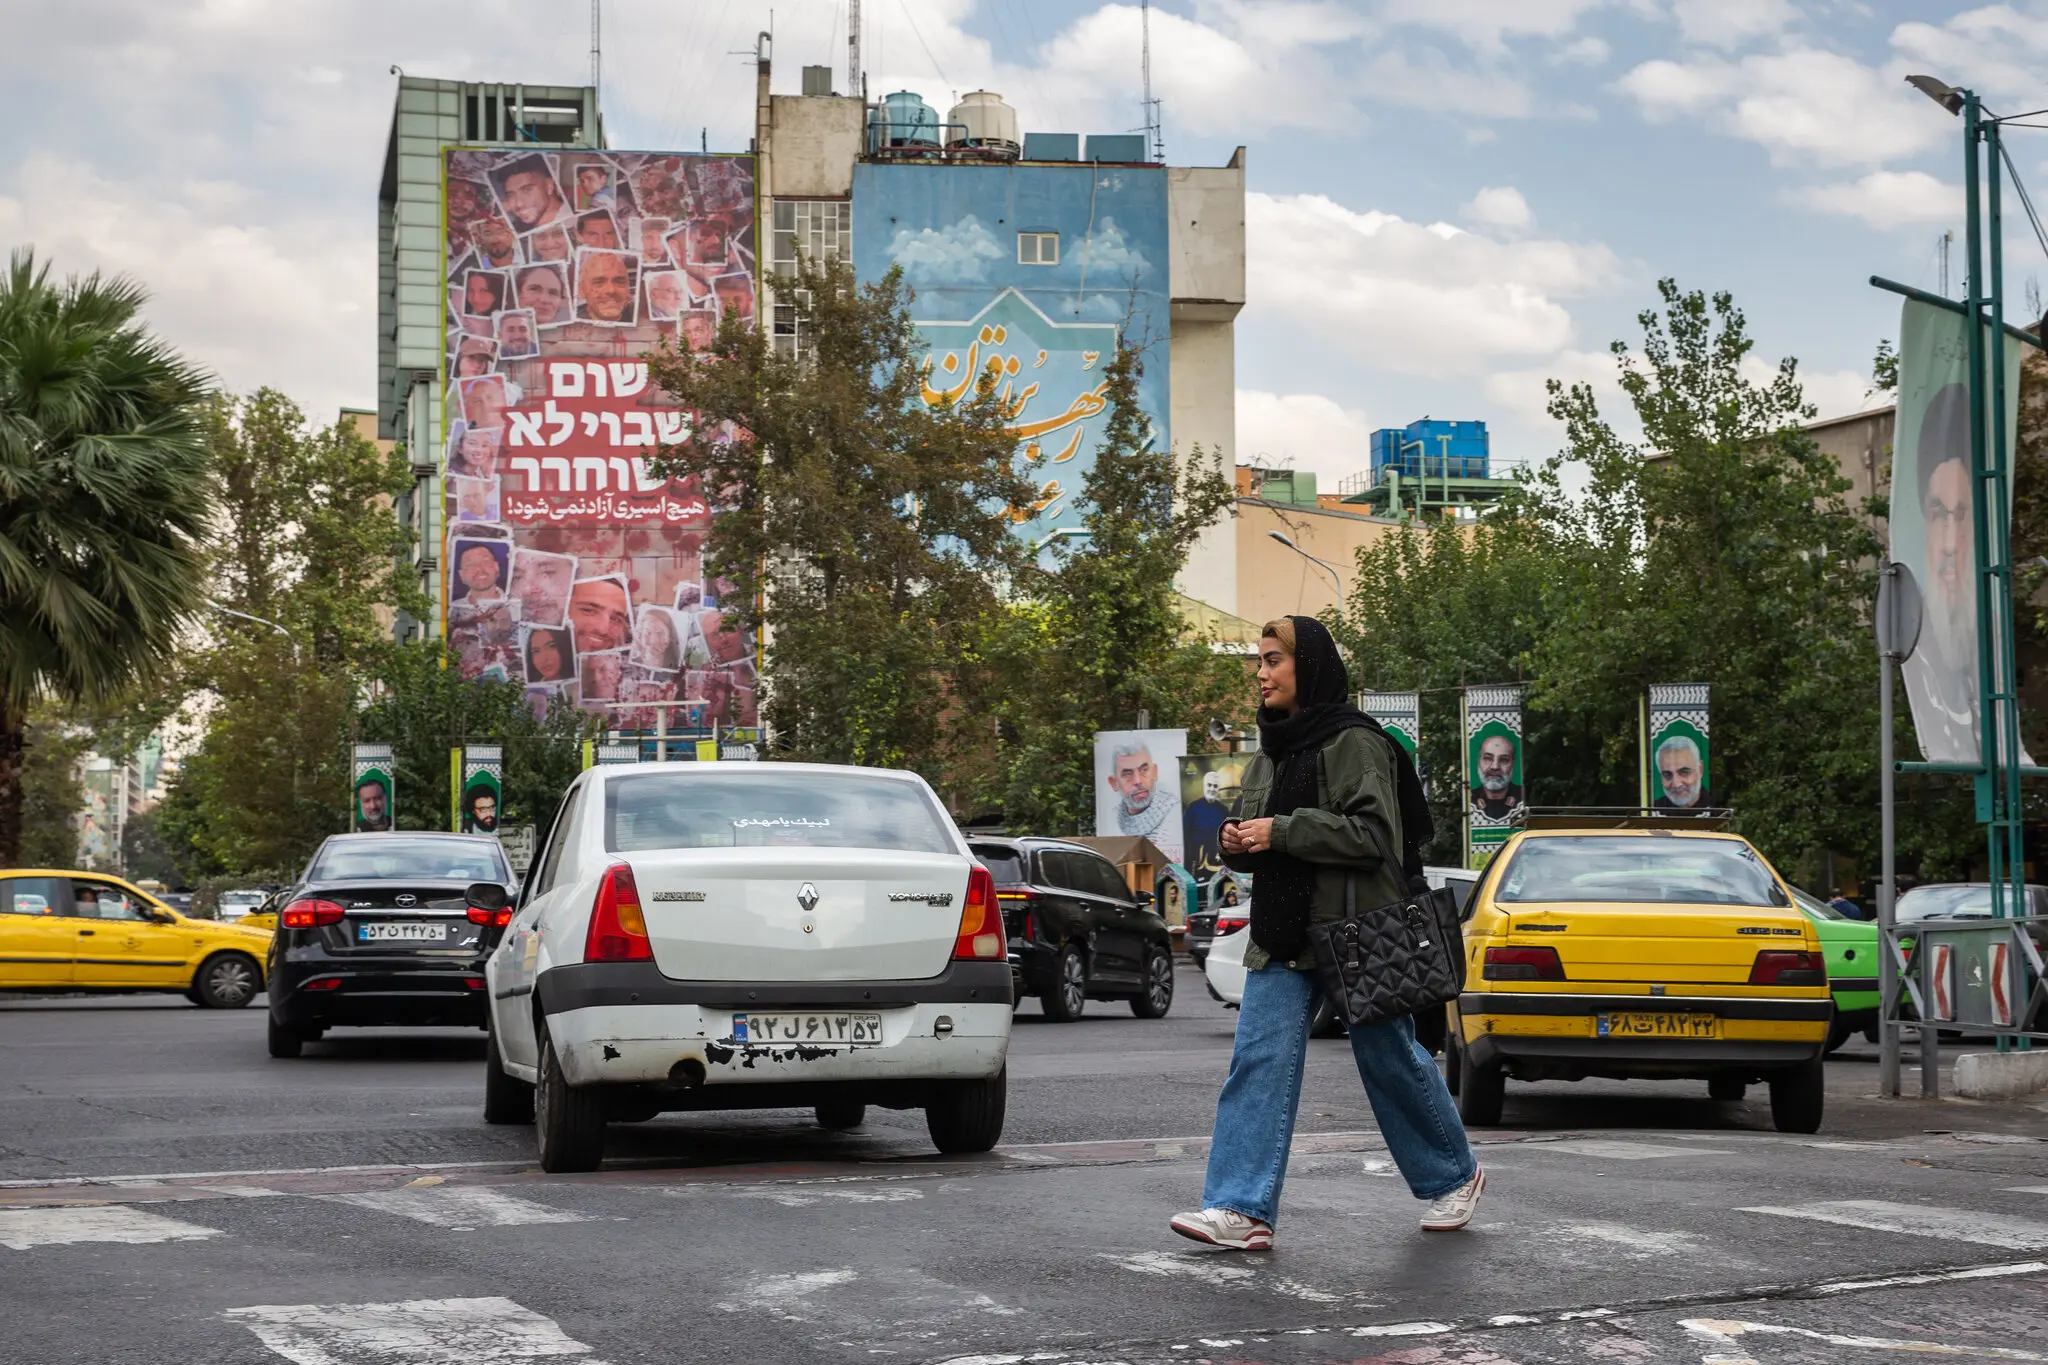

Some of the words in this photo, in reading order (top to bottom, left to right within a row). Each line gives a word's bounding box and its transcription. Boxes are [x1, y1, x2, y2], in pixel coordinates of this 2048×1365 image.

[549, 362, 648, 397] שום
[506, 400, 575, 446] לא
[580, 411, 694, 447] שבוי
[586, 492, 614, 519] آزاد
[613, 496, 666, 518] اسیری
[666, 500, 705, 521] هیچ
[750, 1017, 778, 1039] ۹۲
[784, 1017, 799, 1039] ل
[805, 1017, 848, 1039] ۶۱۳
[853, 1021, 879, 1040] ۵۳
